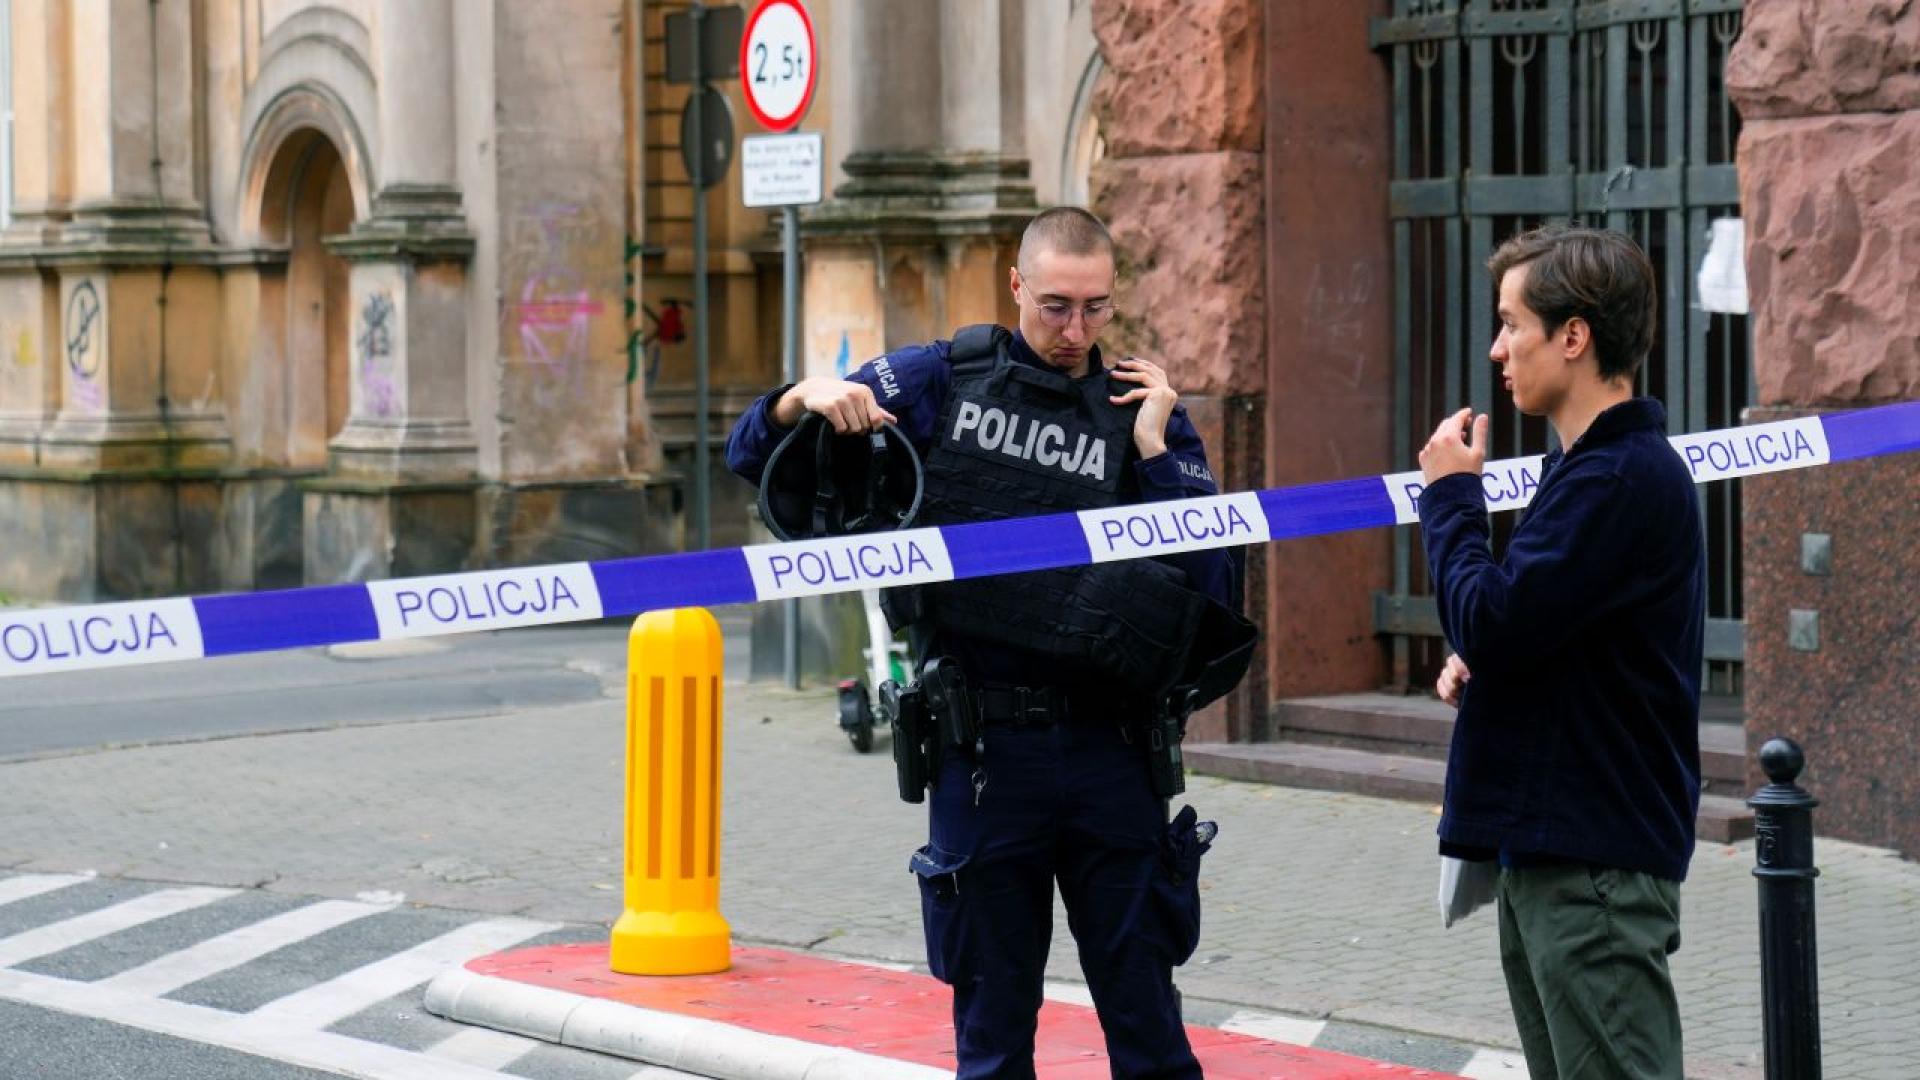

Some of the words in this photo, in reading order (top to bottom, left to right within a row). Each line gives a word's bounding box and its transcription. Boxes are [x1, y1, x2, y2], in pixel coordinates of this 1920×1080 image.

[754, 42, 804, 86] 2,5t
[872, 357, 900, 399] POLICJA
[951, 400, 1107, 481] POLICJA
[1684, 429, 1816, 475] POLICJA
[1404, 467, 1540, 514] PCJA
[1100, 503, 1253, 552] POLICJA
[767, 541, 935, 589] POLICJA
[395, 575, 580, 628] POLICJA
[2, 612, 178, 663] OLICJA
